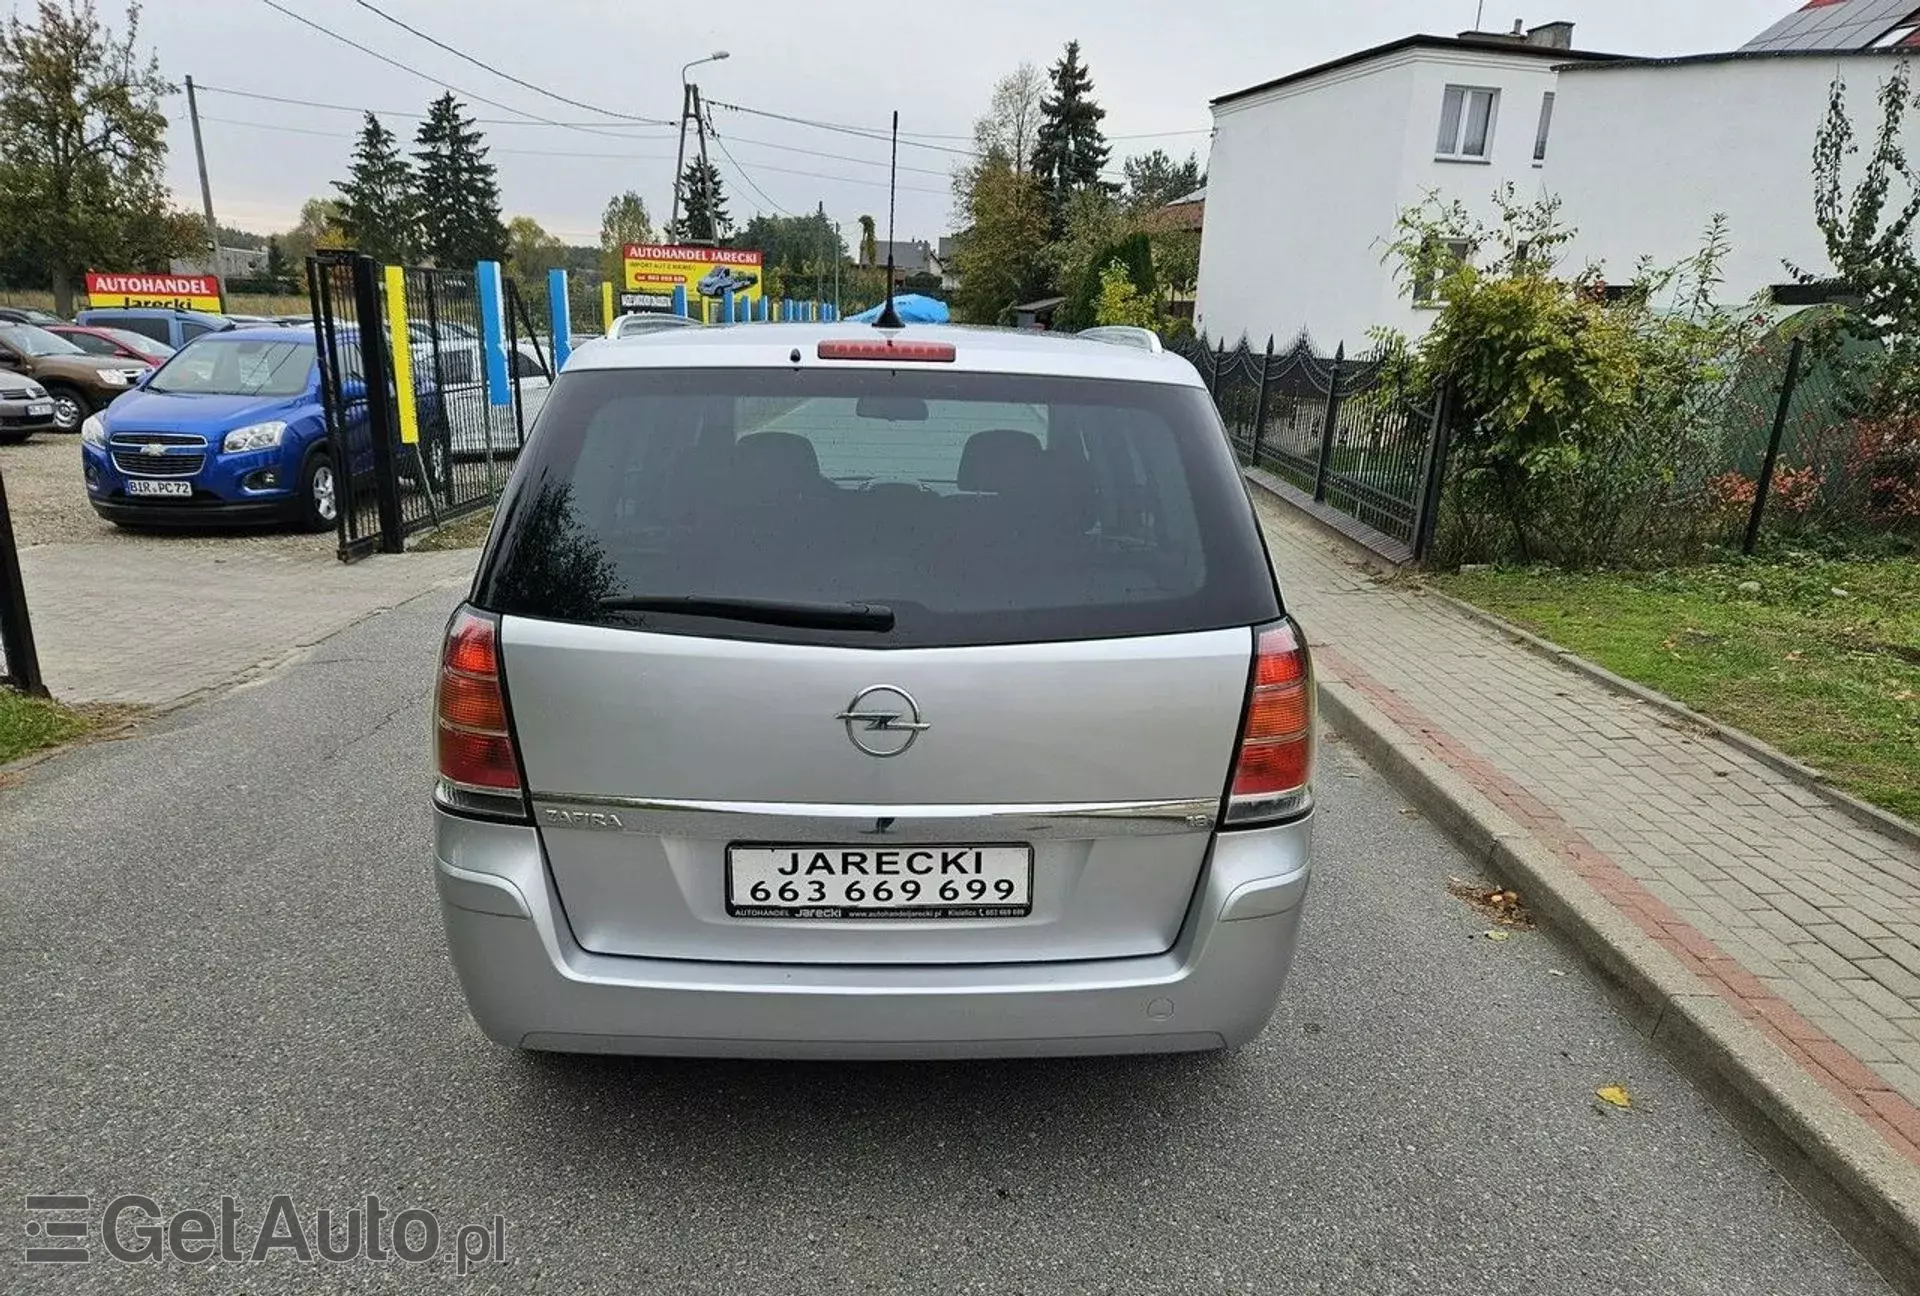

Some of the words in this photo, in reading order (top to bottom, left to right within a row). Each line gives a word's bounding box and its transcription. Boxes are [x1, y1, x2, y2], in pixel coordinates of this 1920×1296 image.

[630, 247, 708, 262] AUTOHANDEL
[711, 251, 757, 264] JARECKI
[95, 277, 211, 294] AUTOHANDEL
[130, 481, 151, 493] BIR
[545, 808, 624, 827] ZAFIRA
[777, 850, 983, 876] JARECKI
[749, 880, 827, 902] 663
[844, 880, 922, 902] 669
[938, 878, 1015, 901] 699
[734, 909, 790, 917] AUTOHANDEL
[794, 908, 842, 918] Jarecki
